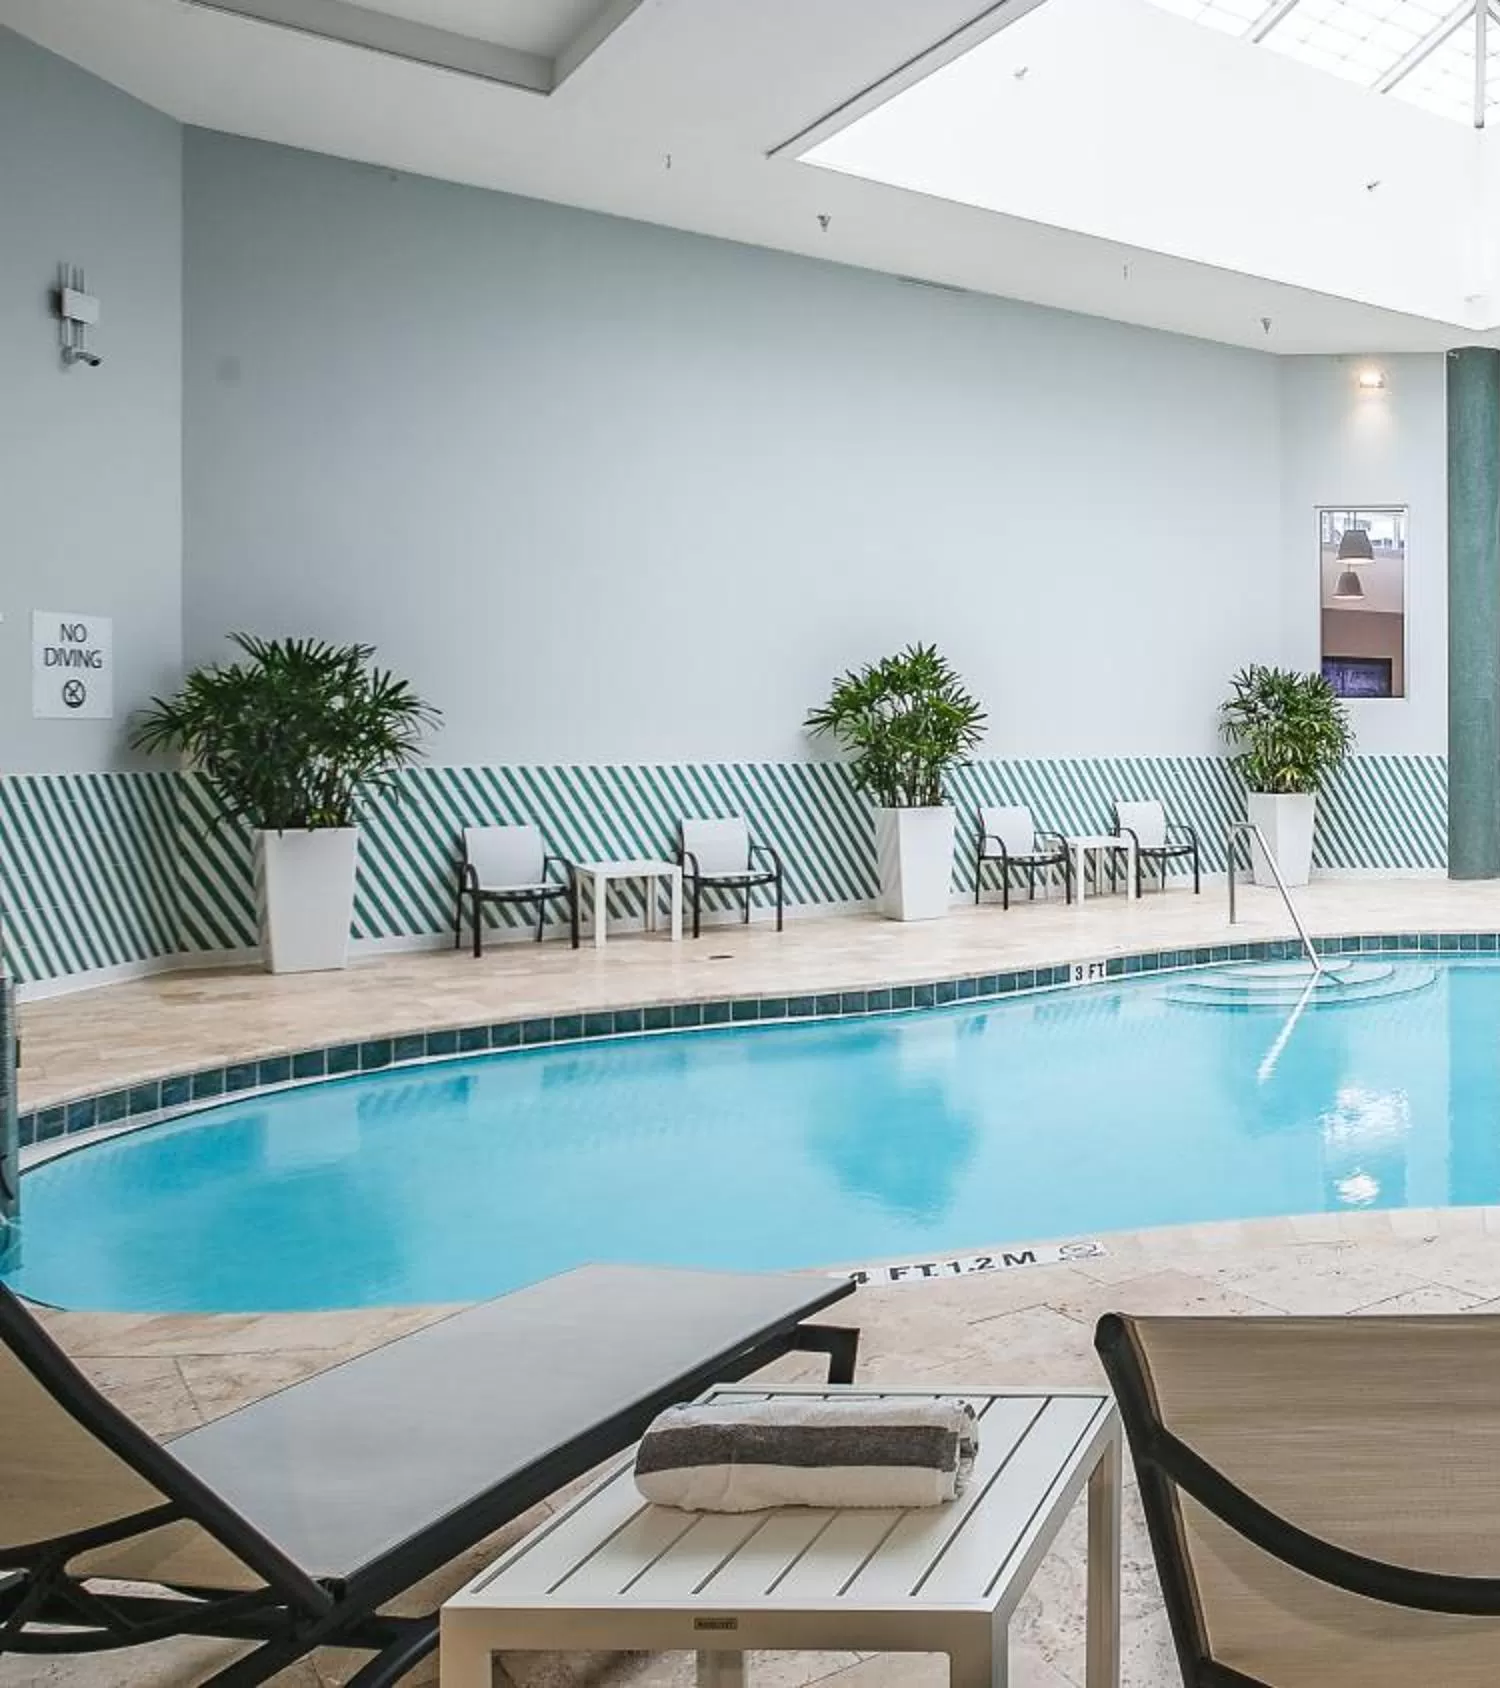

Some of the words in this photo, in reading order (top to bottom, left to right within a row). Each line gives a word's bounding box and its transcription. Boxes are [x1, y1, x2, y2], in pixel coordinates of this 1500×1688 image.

[60, 623, 87, 643] NO
[44, 647, 103, 669] DIVING
[1075, 965, 1083, 981] 3
[1089, 962, 1104, 979] FT
[848, 1271, 870, 1284] 4
[946, 1257, 995, 1273] 1.2
[1003, 1251, 1037, 1267] M
